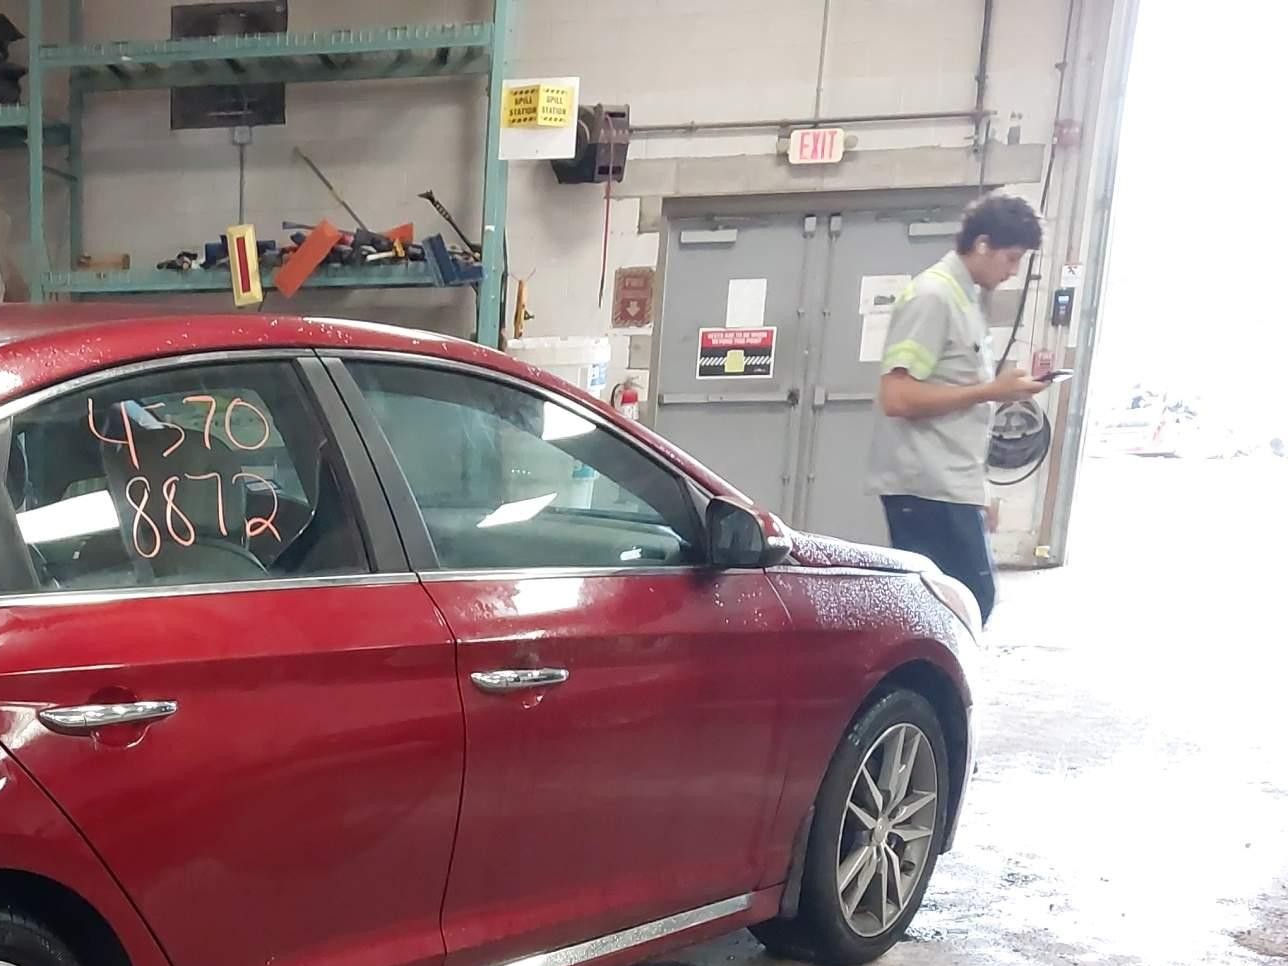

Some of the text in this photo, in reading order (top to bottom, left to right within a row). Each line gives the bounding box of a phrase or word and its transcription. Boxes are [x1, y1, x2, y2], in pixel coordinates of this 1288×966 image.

[509, 107, 537, 116] STATION
[542, 106, 567, 115] STATION
[800, 131, 838, 160] EXIT
[88, 395, 270, 470] 4570
[125, 472, 281, 558] 8872
